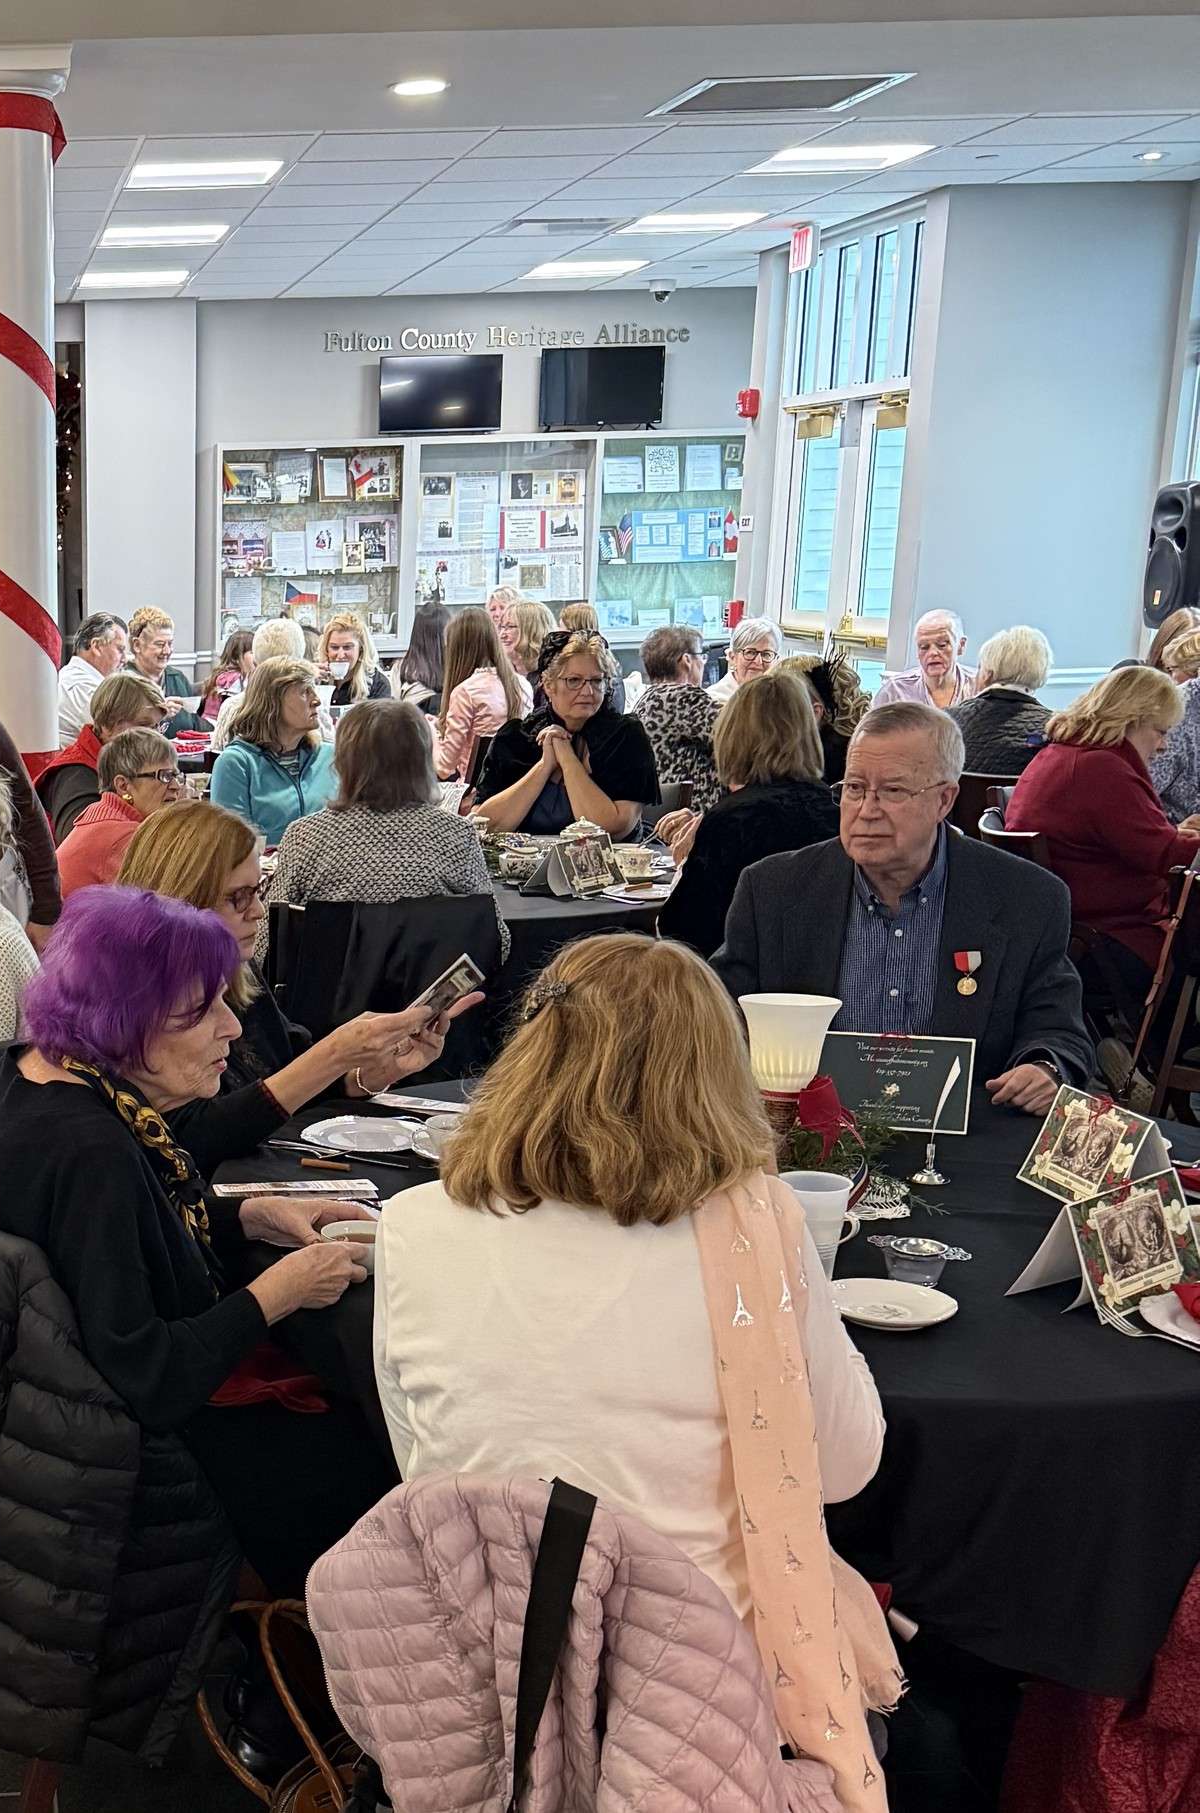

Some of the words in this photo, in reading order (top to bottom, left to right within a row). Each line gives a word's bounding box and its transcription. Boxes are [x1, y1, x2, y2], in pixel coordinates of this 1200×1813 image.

[324, 331, 393, 353] Fulton
[400, 327, 478, 353] County
[486, 325, 585, 348] Heritage
[594, 323, 690, 346] Alliance
[741, 517, 750, 527] EXIT
